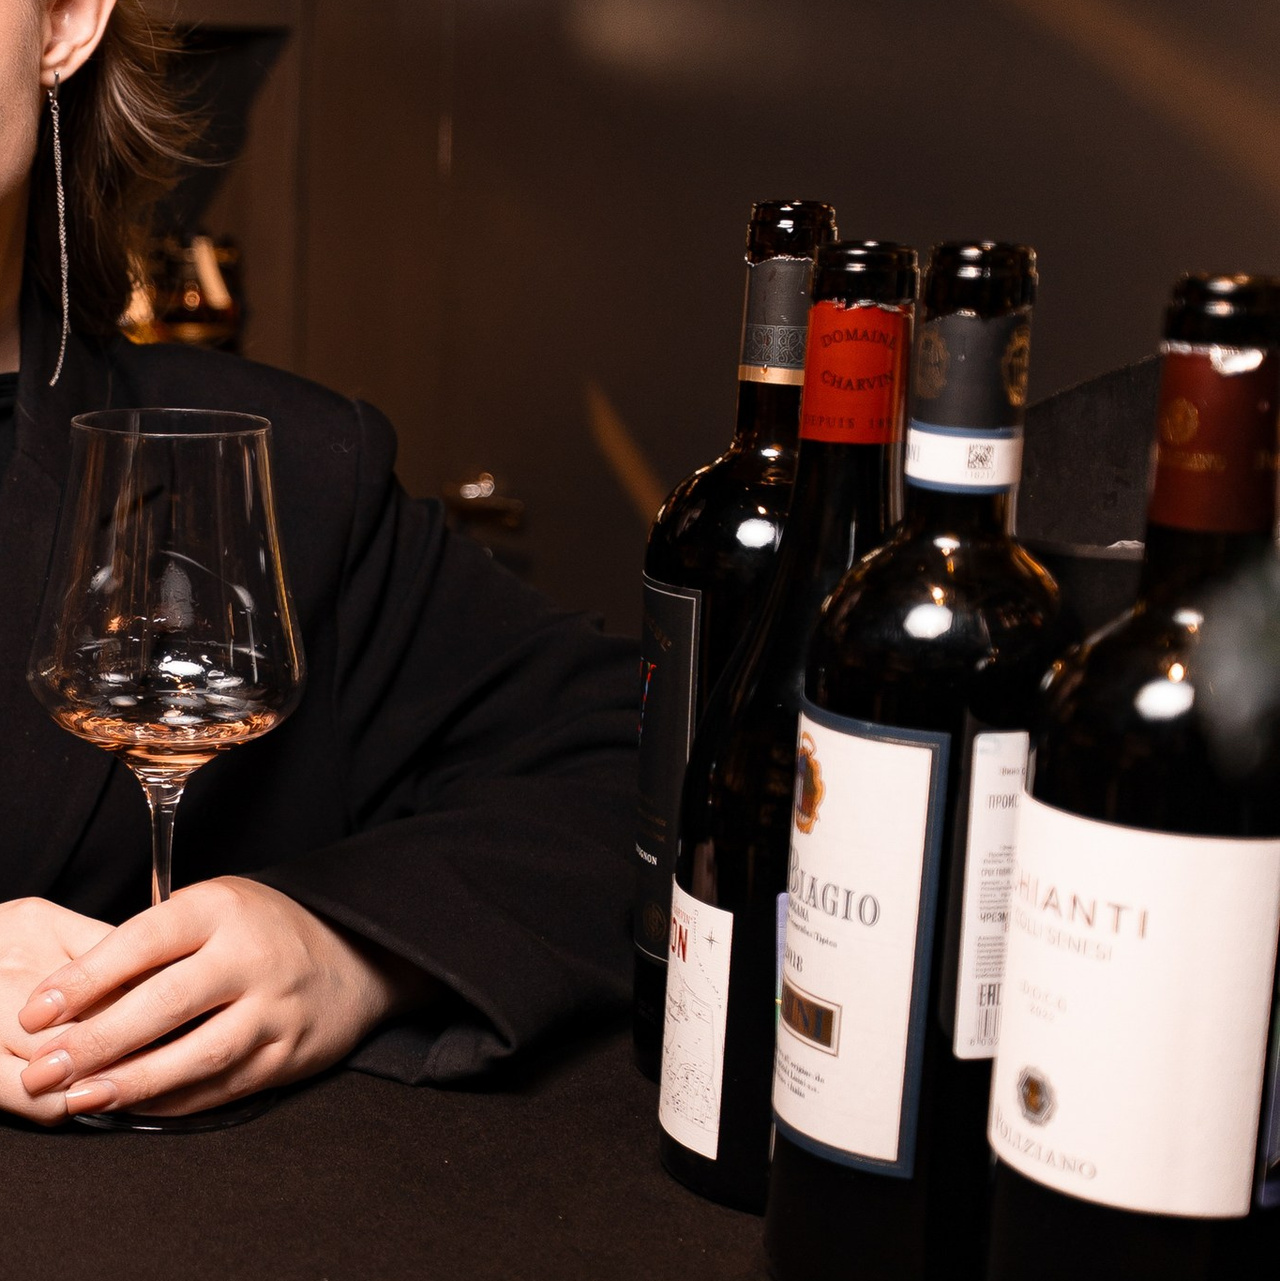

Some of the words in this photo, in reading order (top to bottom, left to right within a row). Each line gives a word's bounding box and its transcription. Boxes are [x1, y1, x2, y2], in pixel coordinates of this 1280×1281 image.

[821, 328, 897, 350] DOMAINE
[821, 369, 896, 391] CHARVIN
[1014, 869, 1149, 940] HIANTI
